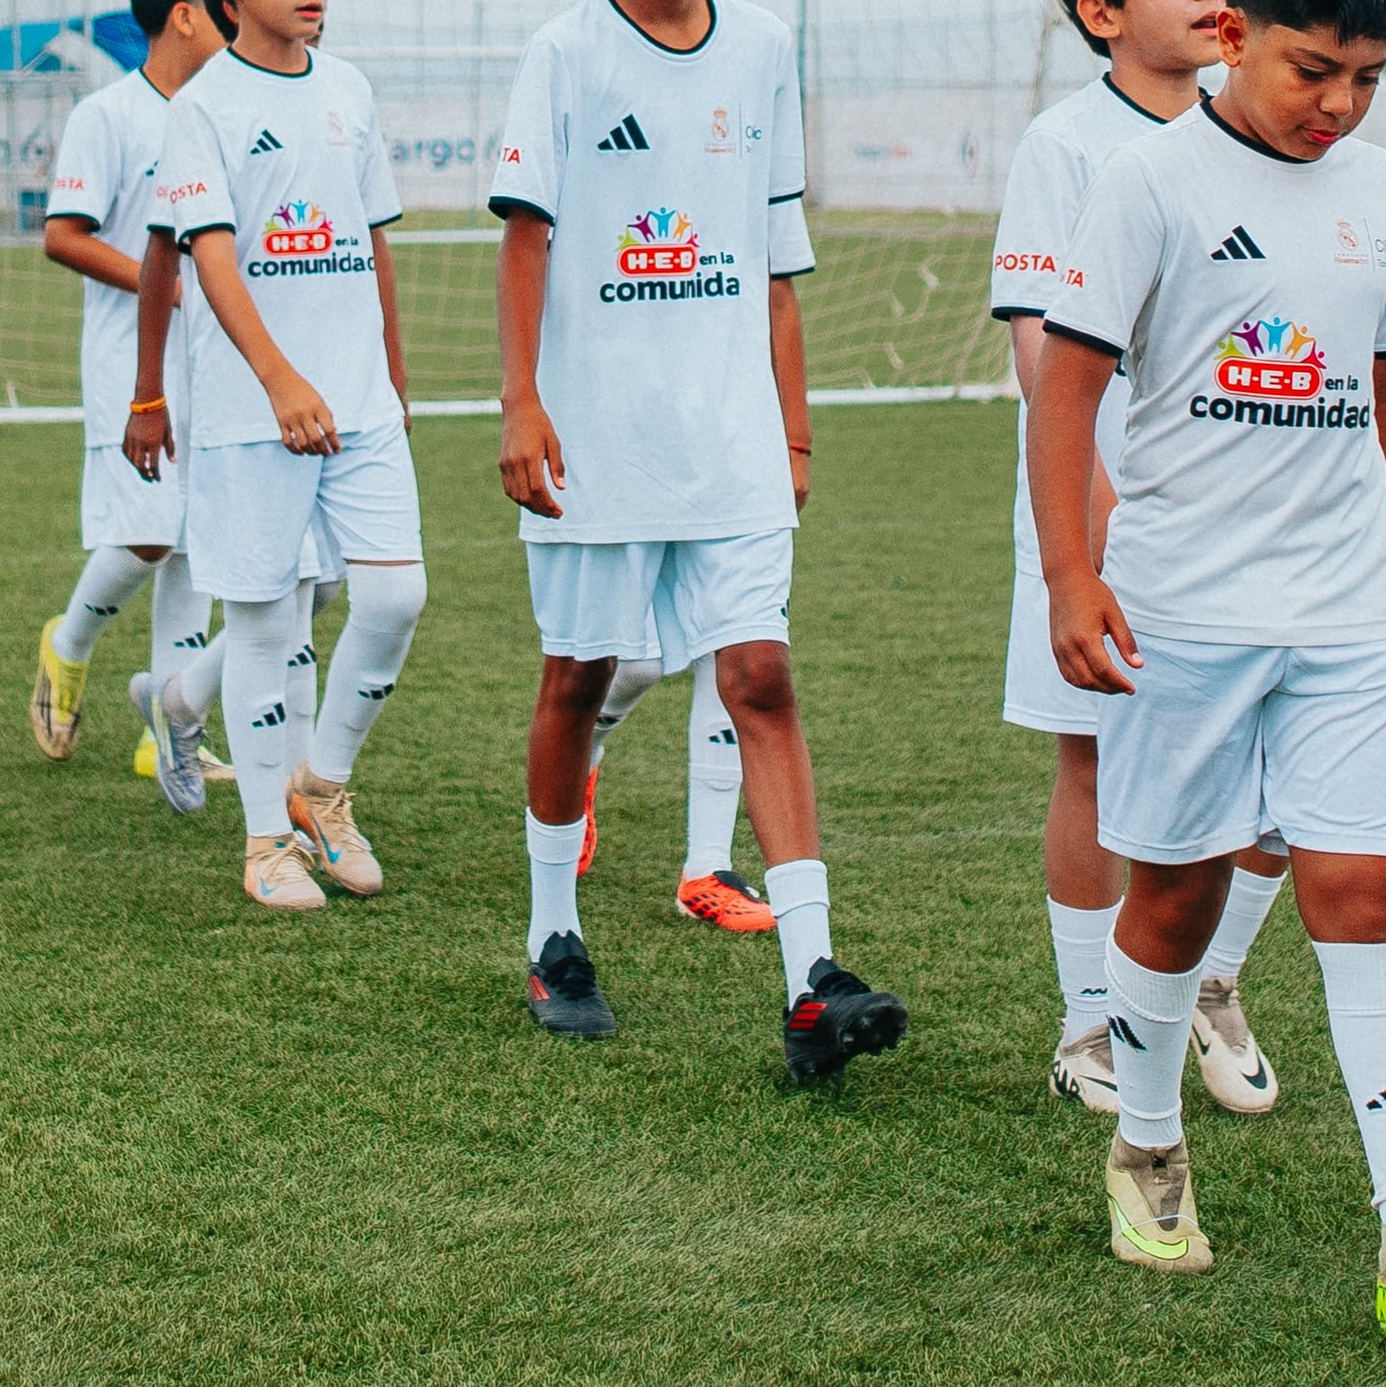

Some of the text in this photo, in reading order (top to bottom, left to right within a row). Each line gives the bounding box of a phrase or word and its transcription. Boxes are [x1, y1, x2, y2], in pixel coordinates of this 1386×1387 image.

[699, 255, 717, 265] en
[720, 252, 734, 264] la
[600, 272, 740, 303] comunida
[1227, 366, 1358, 390] H-E-B en la
